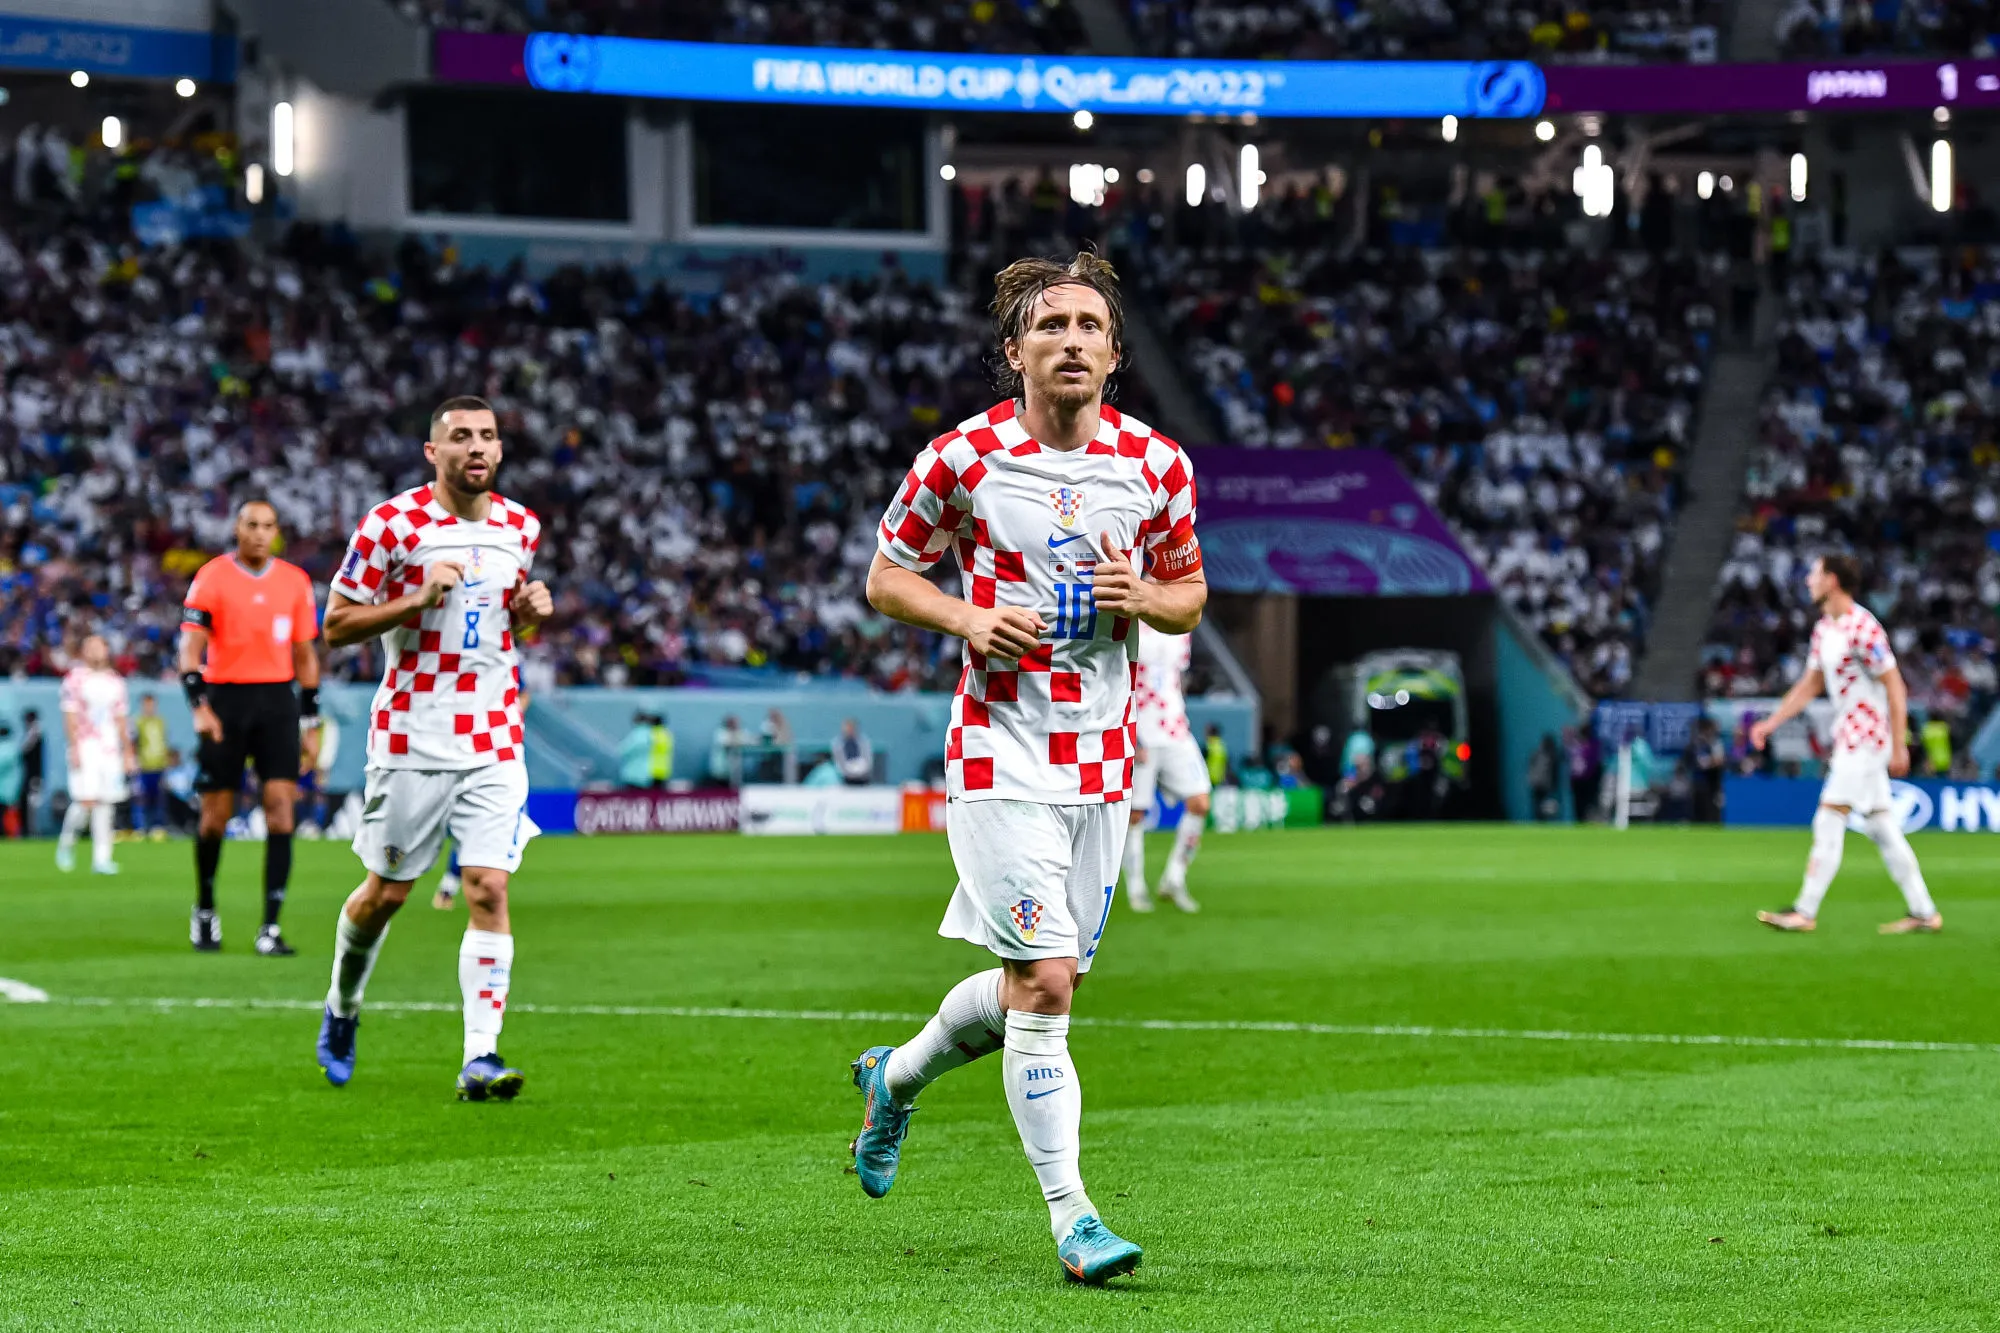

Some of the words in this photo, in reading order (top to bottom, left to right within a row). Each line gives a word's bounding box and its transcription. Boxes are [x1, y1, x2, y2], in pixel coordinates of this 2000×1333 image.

[753, 59, 825, 92] FIFA
[825, 62, 945, 98] WORLD
[949, 66, 1013, 99] CUP
[1807, 69, 1887, 104] JAPAN
[1936, 63, 1959, 101] 1
[1165, 559, 1183, 572] FOR
[1185, 550, 1199, 567] ALL
[463, 611, 480, 649] 8
[1051, 583, 1097, 640] 10
